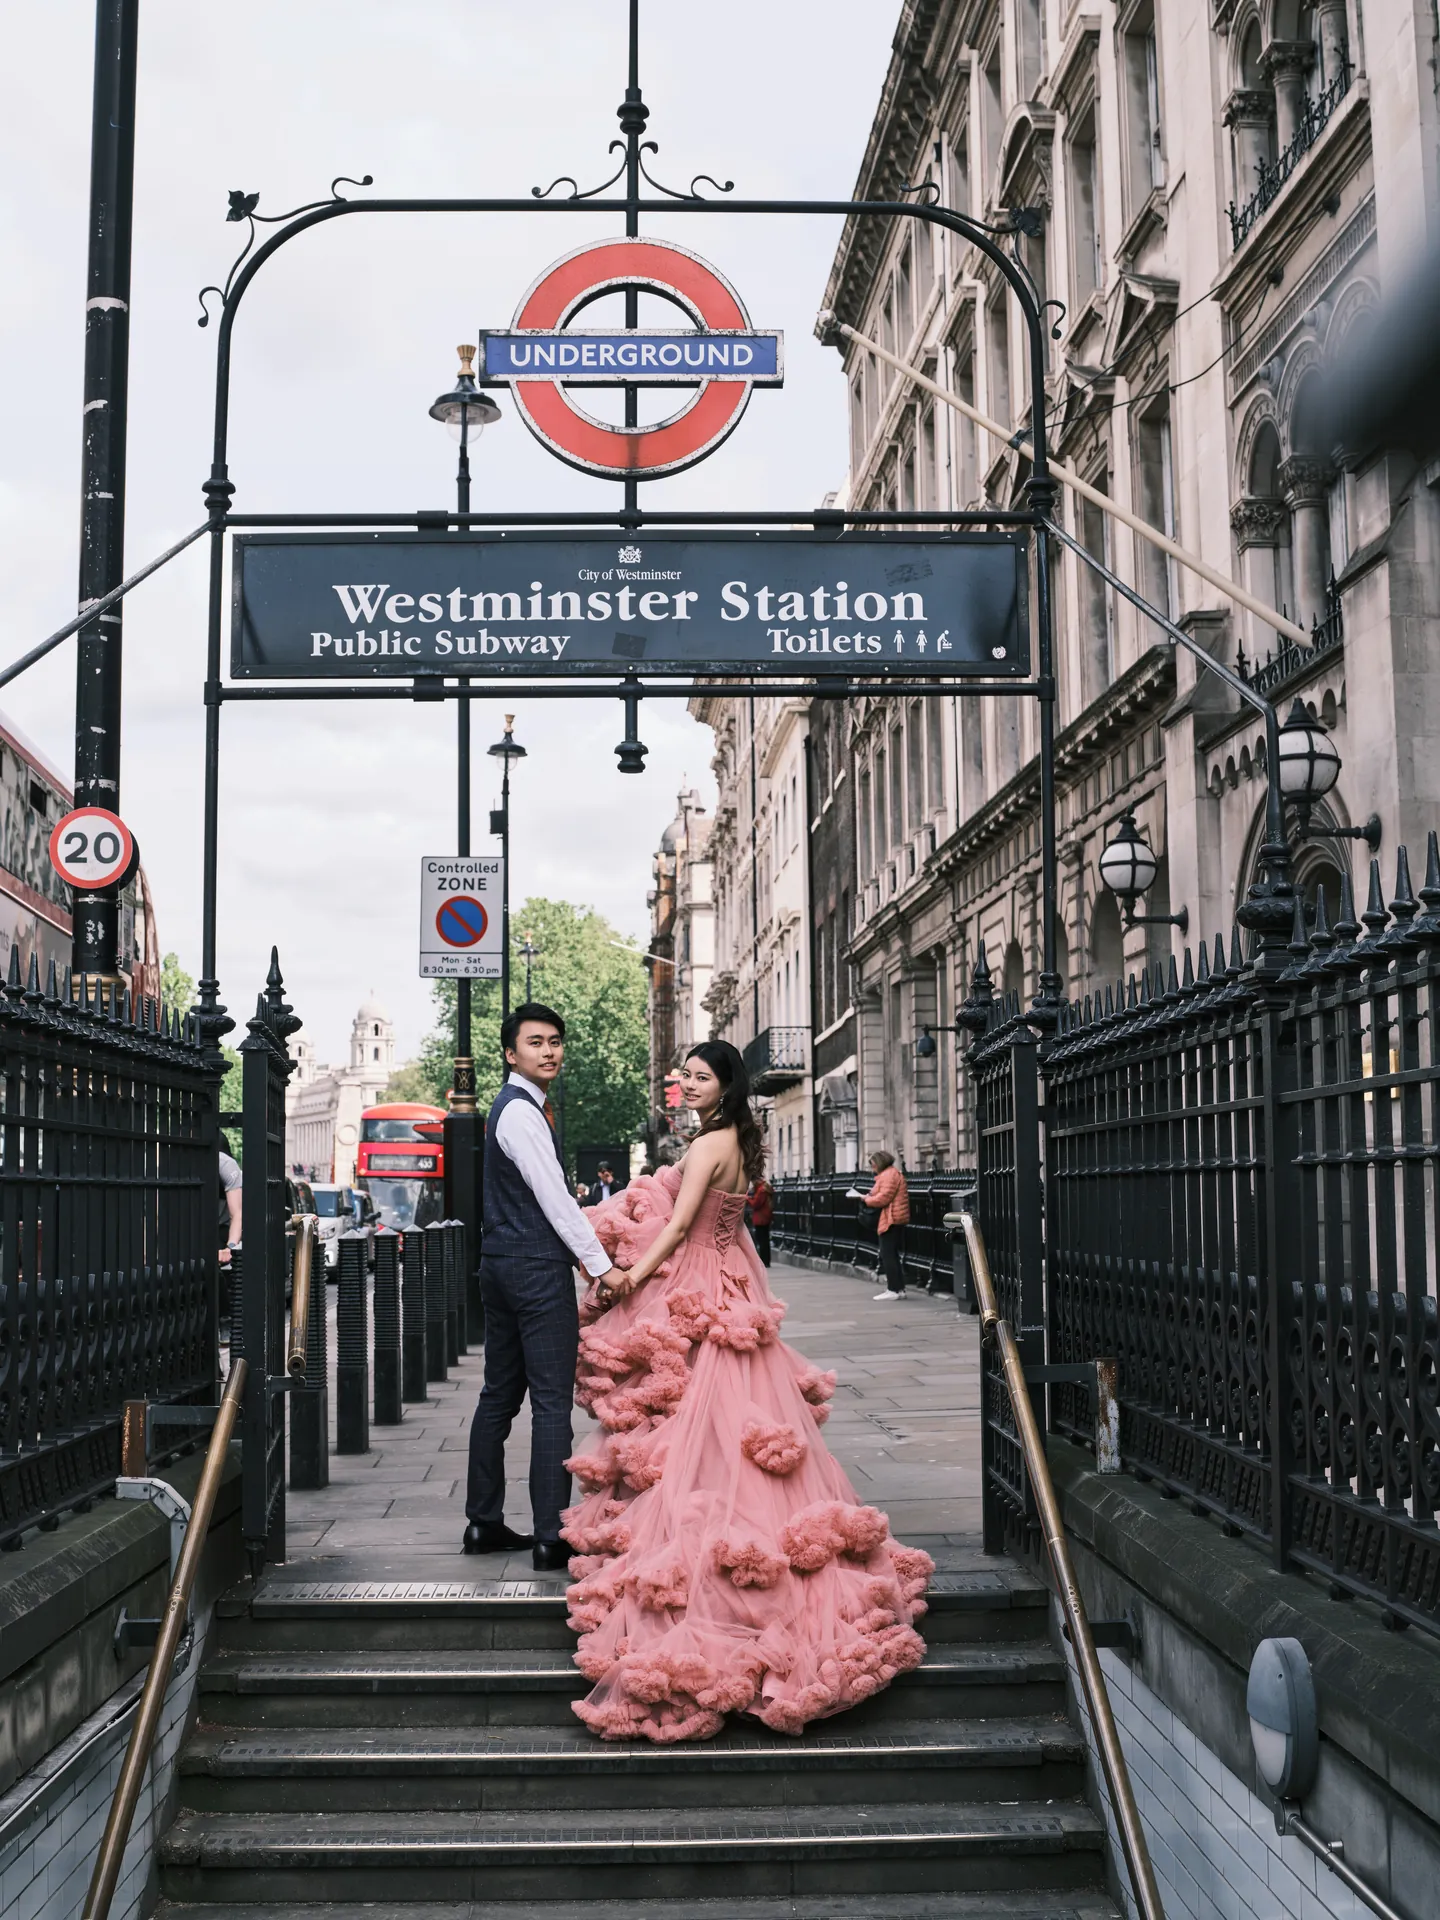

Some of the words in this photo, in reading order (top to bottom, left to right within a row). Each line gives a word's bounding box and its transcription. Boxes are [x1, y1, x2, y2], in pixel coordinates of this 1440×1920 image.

[510, 343, 754, 367] UNDERGROUND
[578, 568, 600, 583] City
[601, 568, 614, 581] of
[615, 568, 682, 581] Westminster
[332, 581, 699, 624] Westminster
[720, 580, 928, 622] Station
[310, 630, 422, 657] Public
[435, 628, 571, 661] Subway
[766, 627, 882, 655] Toilets
[64, 831, 120, 864] 20
[427, 862, 499, 874] Controlled
[437, 877, 487, 891] ZONE
[441, 956, 460, 964] Mon
[466, 956, 482, 964] Sat
[423, 966, 444, 974] 8.30
[464, 966, 485, 974] 6.30
[486, 967, 499, 976] pm
